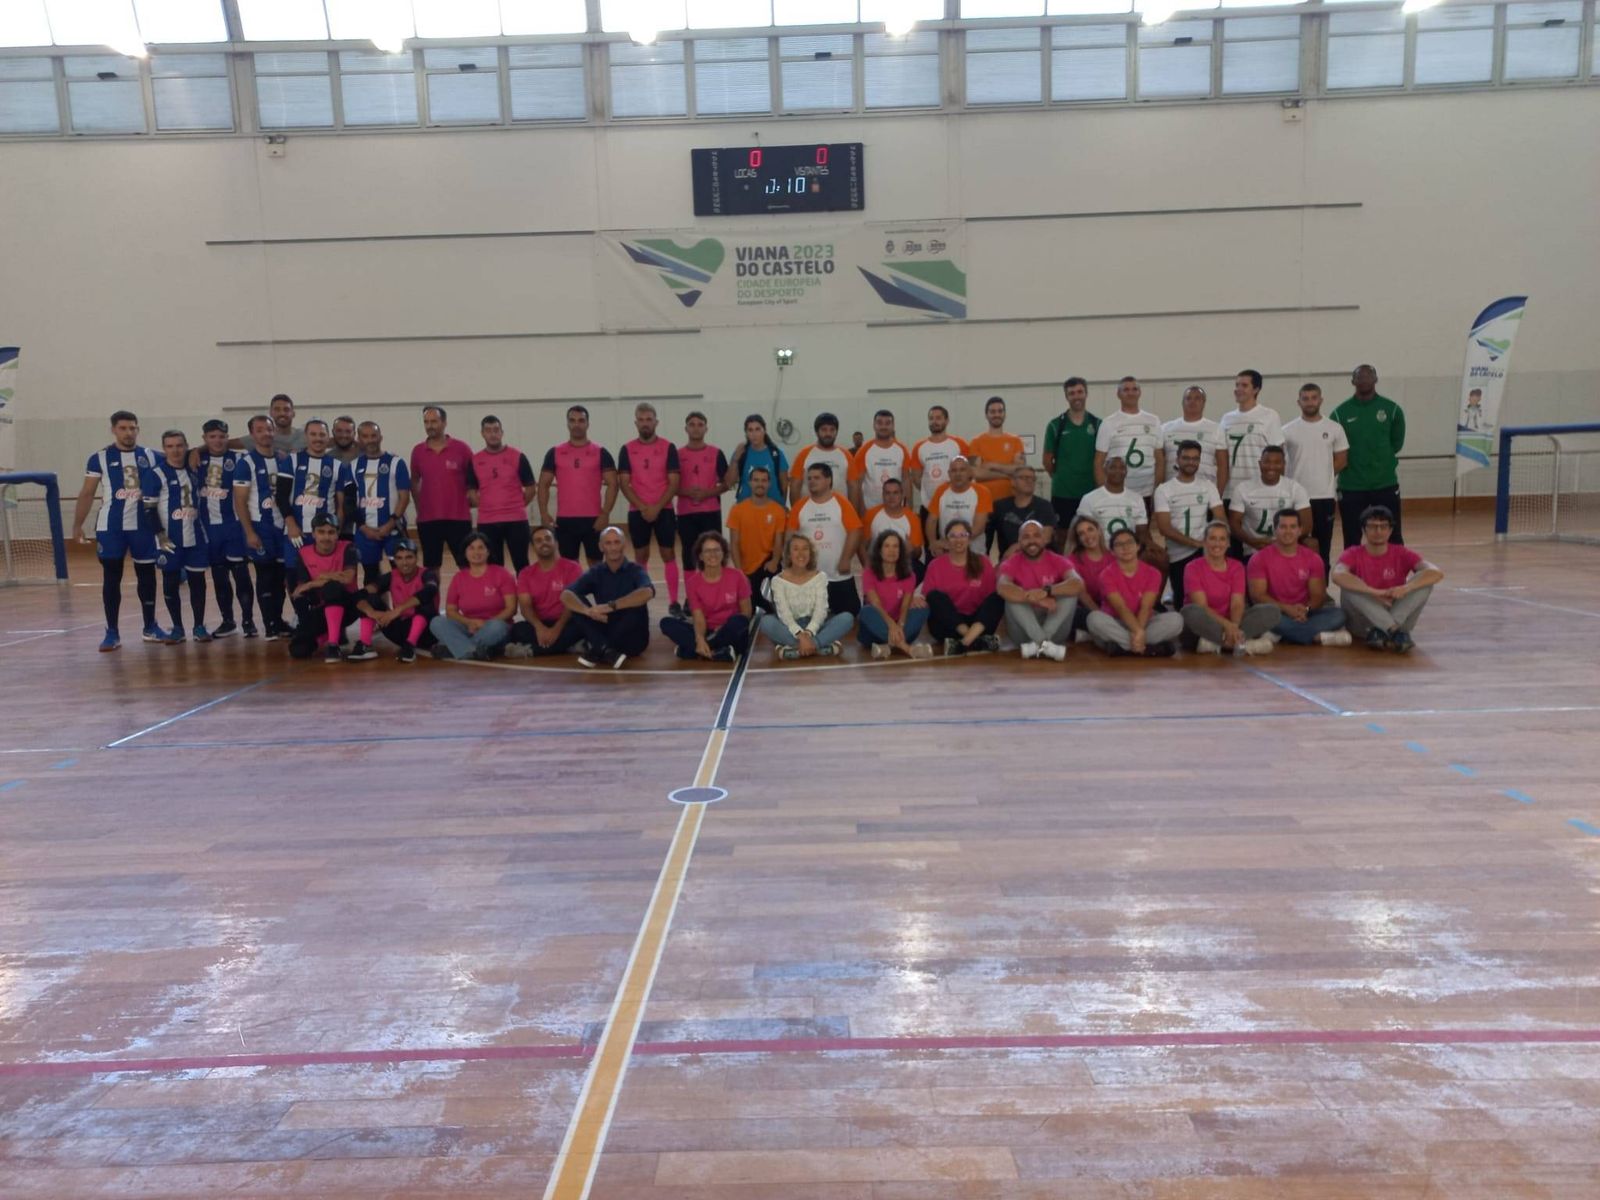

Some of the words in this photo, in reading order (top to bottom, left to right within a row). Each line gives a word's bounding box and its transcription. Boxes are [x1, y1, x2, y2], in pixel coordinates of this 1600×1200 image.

[750, 150, 762, 167] 0
[816, 147, 828, 164] 0
[735, 246, 790, 261] VIANA
[793, 244, 834, 260] 2023
[736, 262, 759, 277] DO
[762, 260, 835, 276] CASTELO
[737, 278, 773, 289] CIDADE
[774, 277, 821, 288] EUROPEIA
[737, 290, 752, 298] DO
[753, 288, 805, 298] DESPORTO
[1125, 437, 1145, 468] 6
[1229, 435, 1245, 466] 7
[305, 472, 321, 496] 2
[363, 473, 378, 498] 7
[1183, 507, 1191, 536] 1
[1256, 509, 1273, 536] 4
